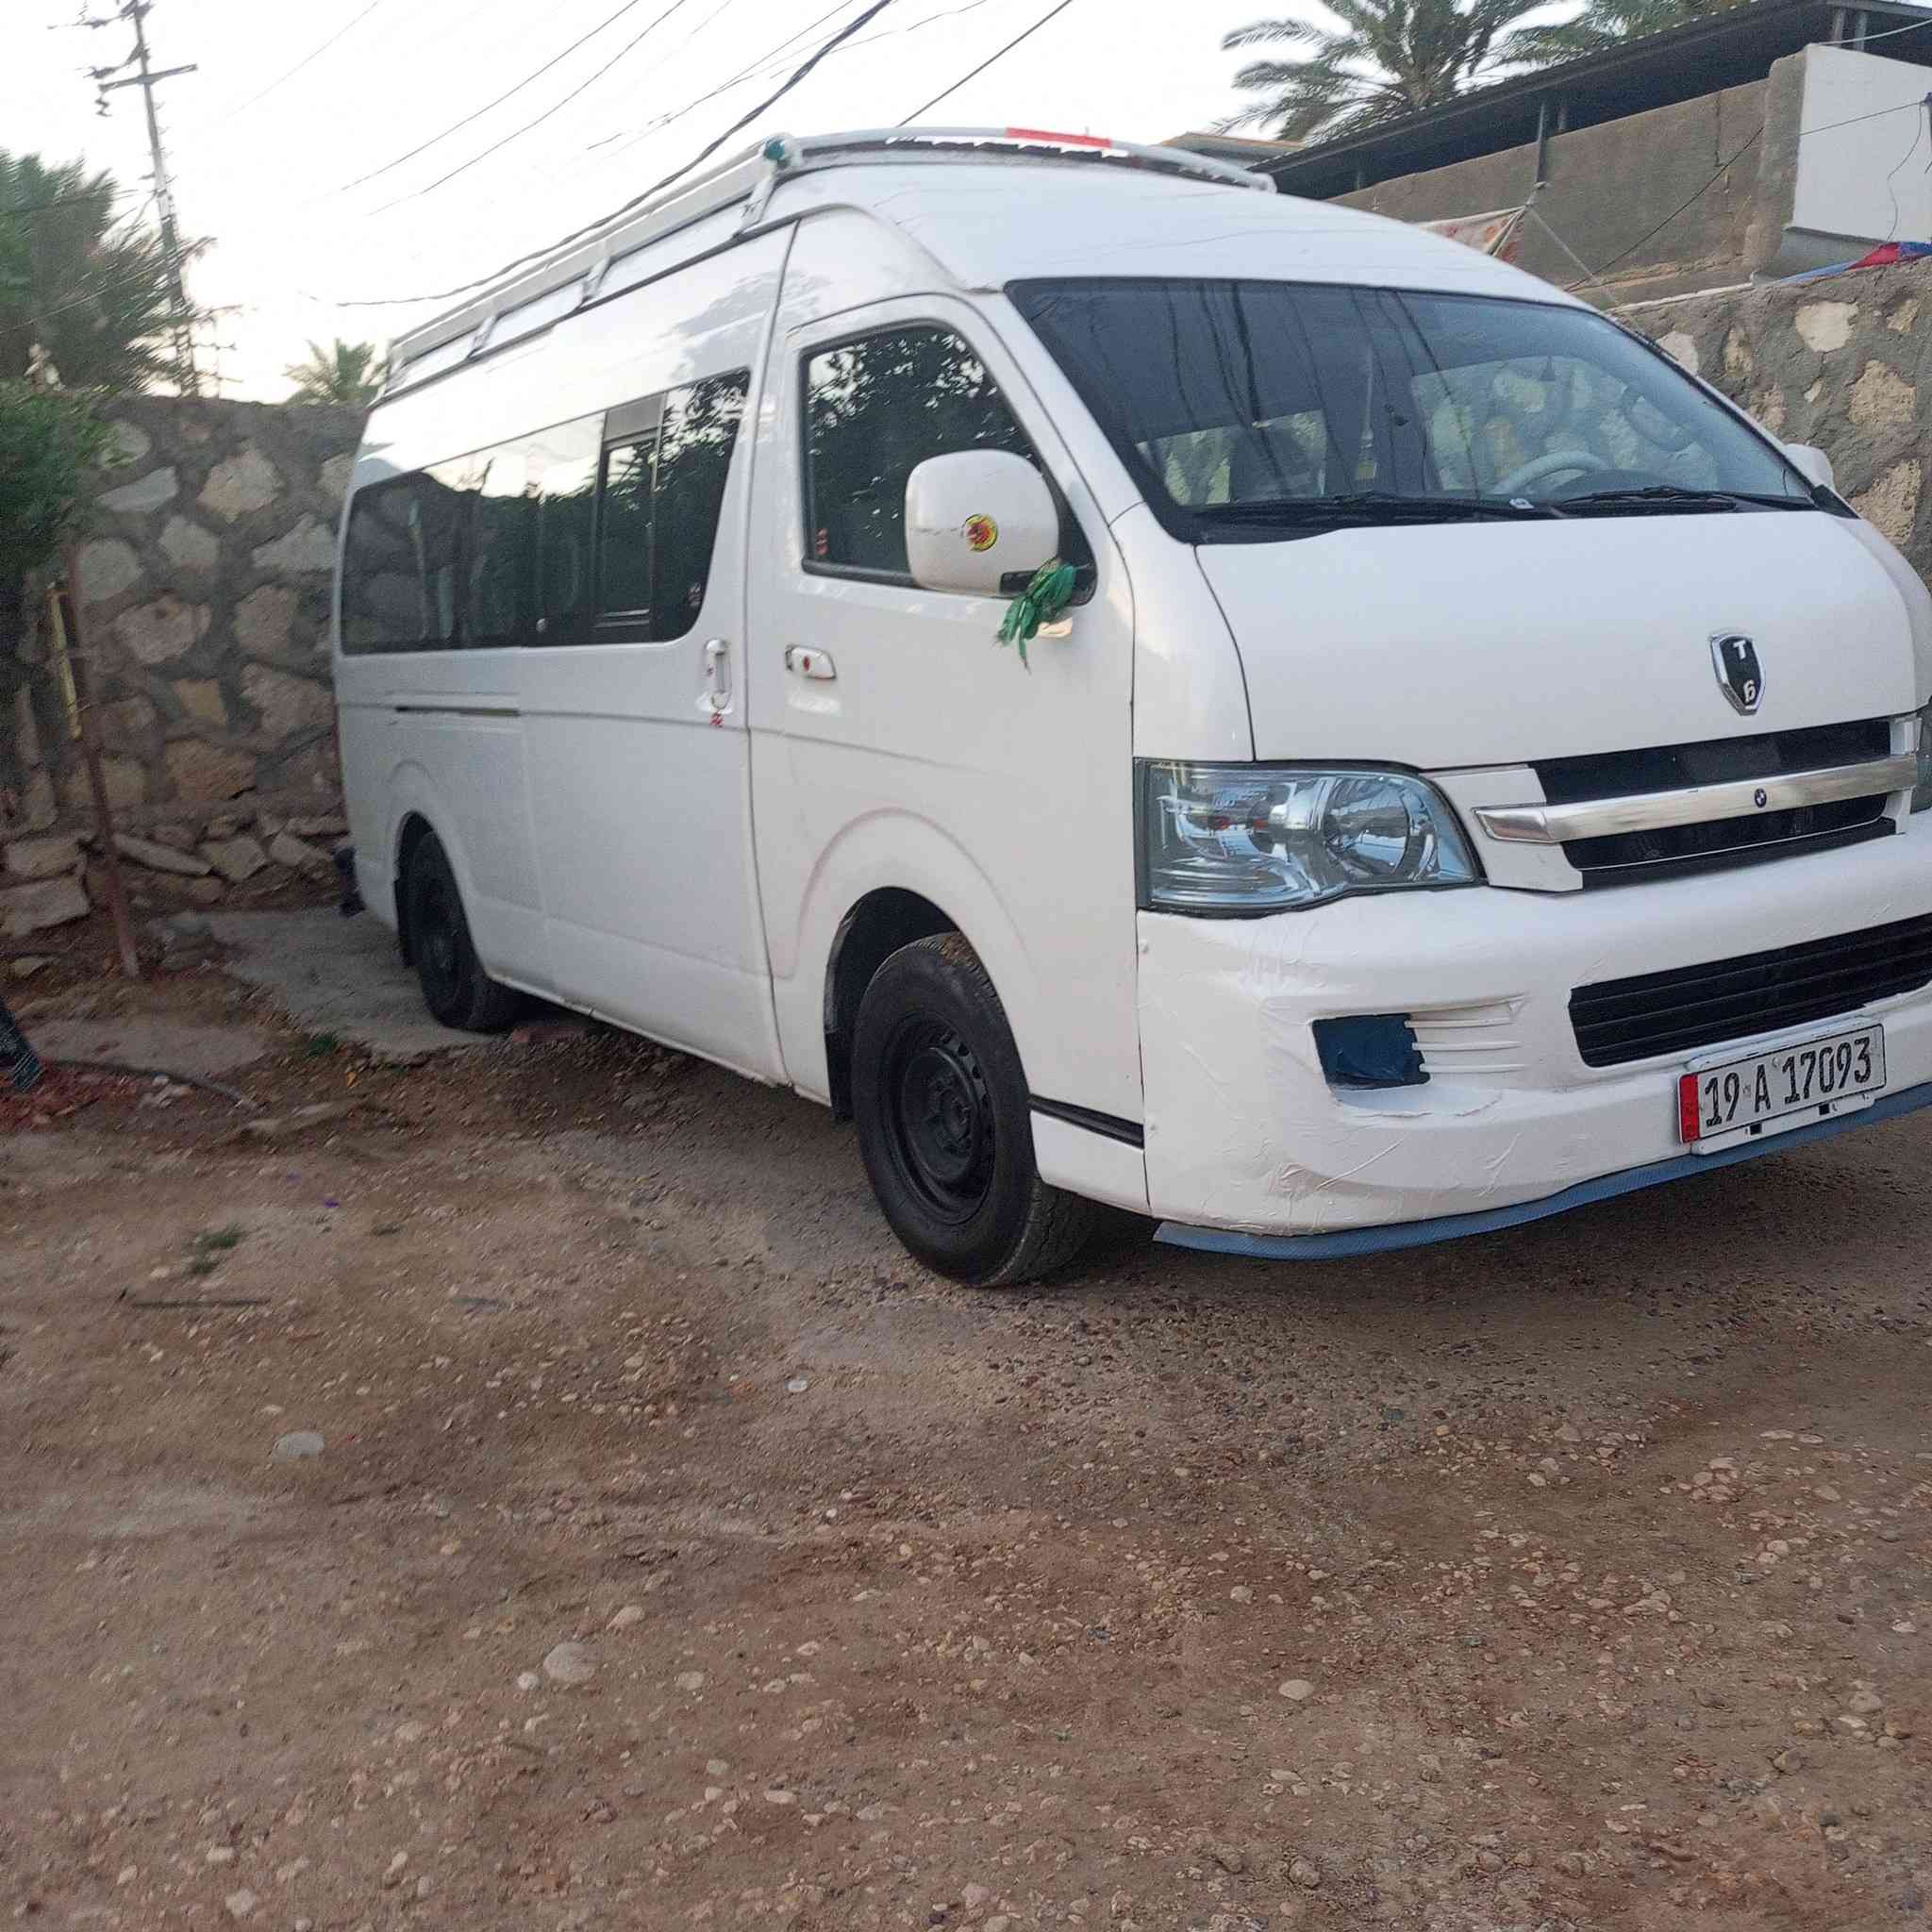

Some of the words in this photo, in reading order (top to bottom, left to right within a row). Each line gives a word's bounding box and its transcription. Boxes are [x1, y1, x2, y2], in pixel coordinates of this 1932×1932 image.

[1733, 640, 1746, 659] T
[1742, 679, 1757, 703] 6
[1705, 1073, 1740, 1126] 19
[1754, 1064, 1771, 1112] A
[1781, 1037, 1872, 1104] 17093
